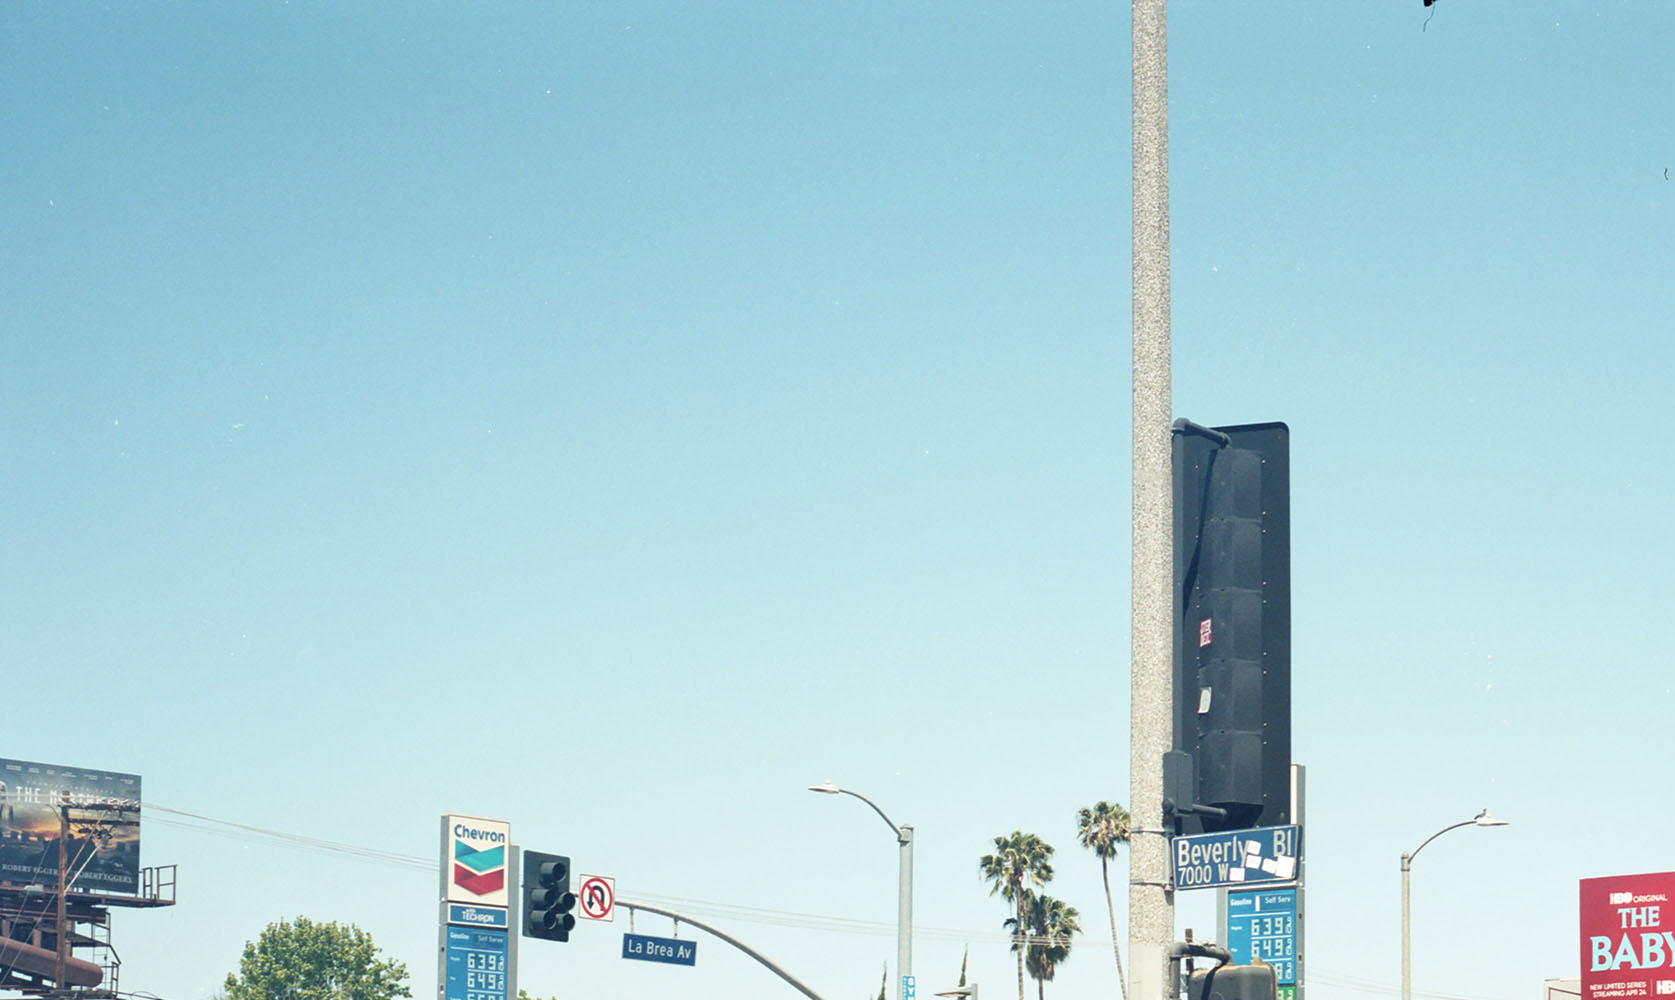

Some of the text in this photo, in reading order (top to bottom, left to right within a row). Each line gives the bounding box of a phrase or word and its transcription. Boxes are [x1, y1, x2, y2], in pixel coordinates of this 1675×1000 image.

[454, 824, 505, 843] Chevron
[1178, 830, 1291, 868] Beverly Bl
[1178, 863, 1229, 885] 7000 W
[1610, 892, 1668, 904] HBO ORIGINAL
[1617, 906, 1660, 928] THE
[628, 939, 691, 959] La Brea Av
[1593, 990, 1625, 998] STREAMING
